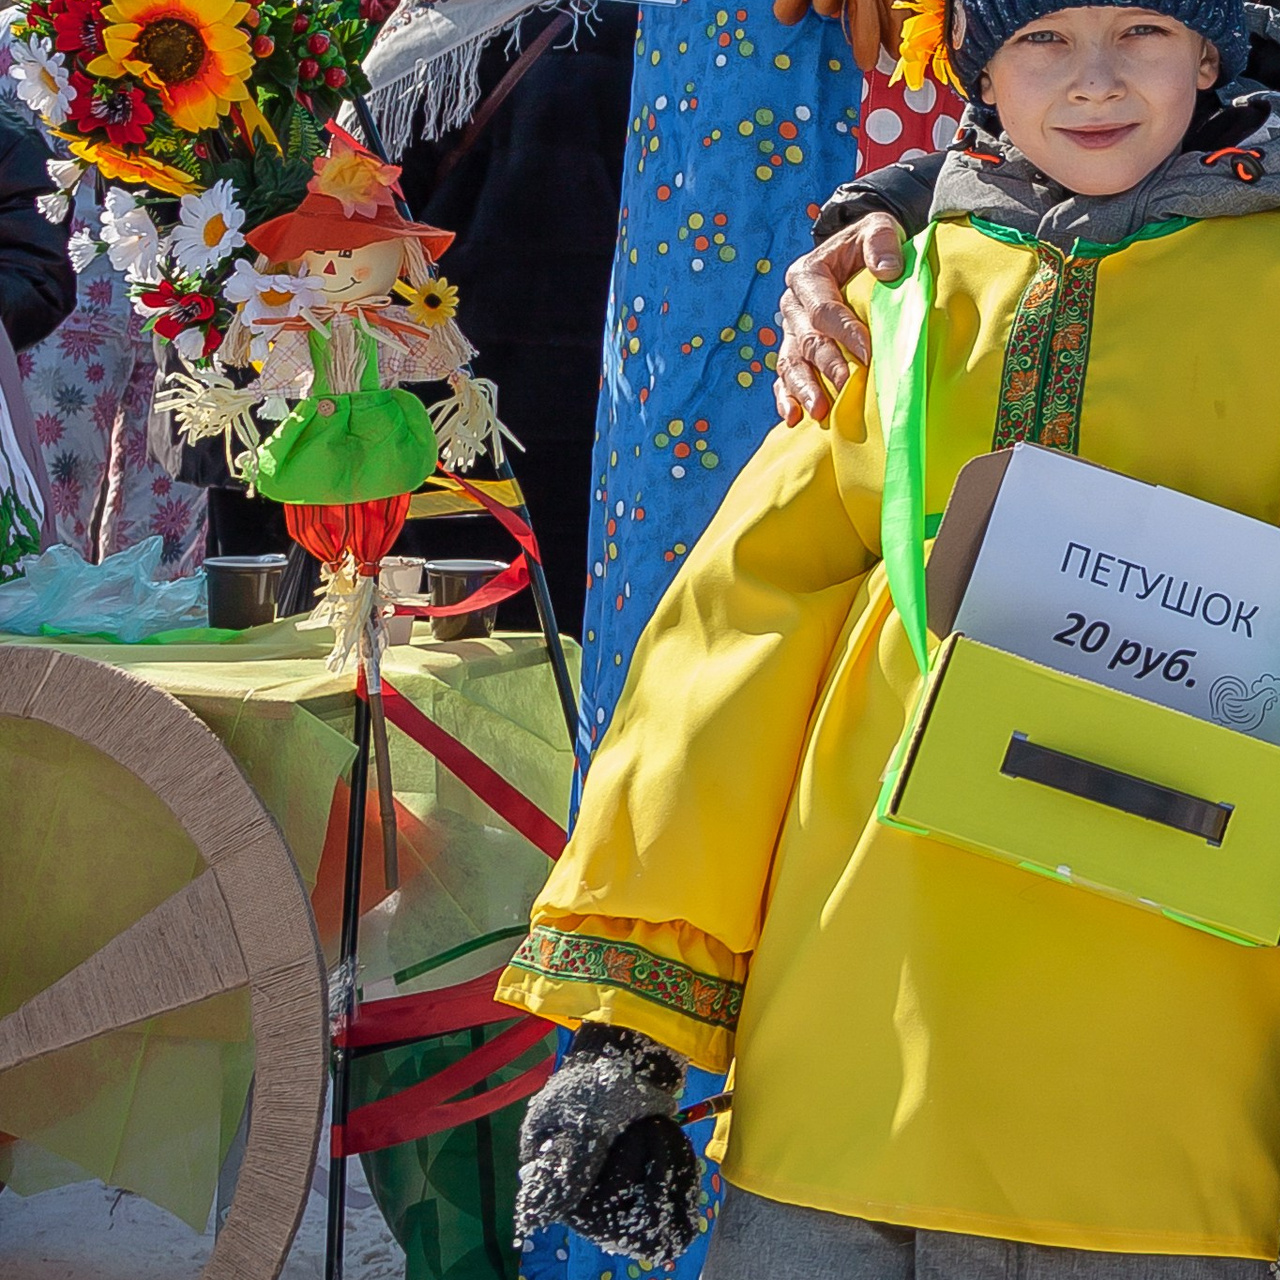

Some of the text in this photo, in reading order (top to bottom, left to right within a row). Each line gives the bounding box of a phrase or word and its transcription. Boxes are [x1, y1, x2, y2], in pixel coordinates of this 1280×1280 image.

[1060, 541, 1260, 638] ПЕТУШОК
[1053, 612, 1197, 688] 20 руб.
